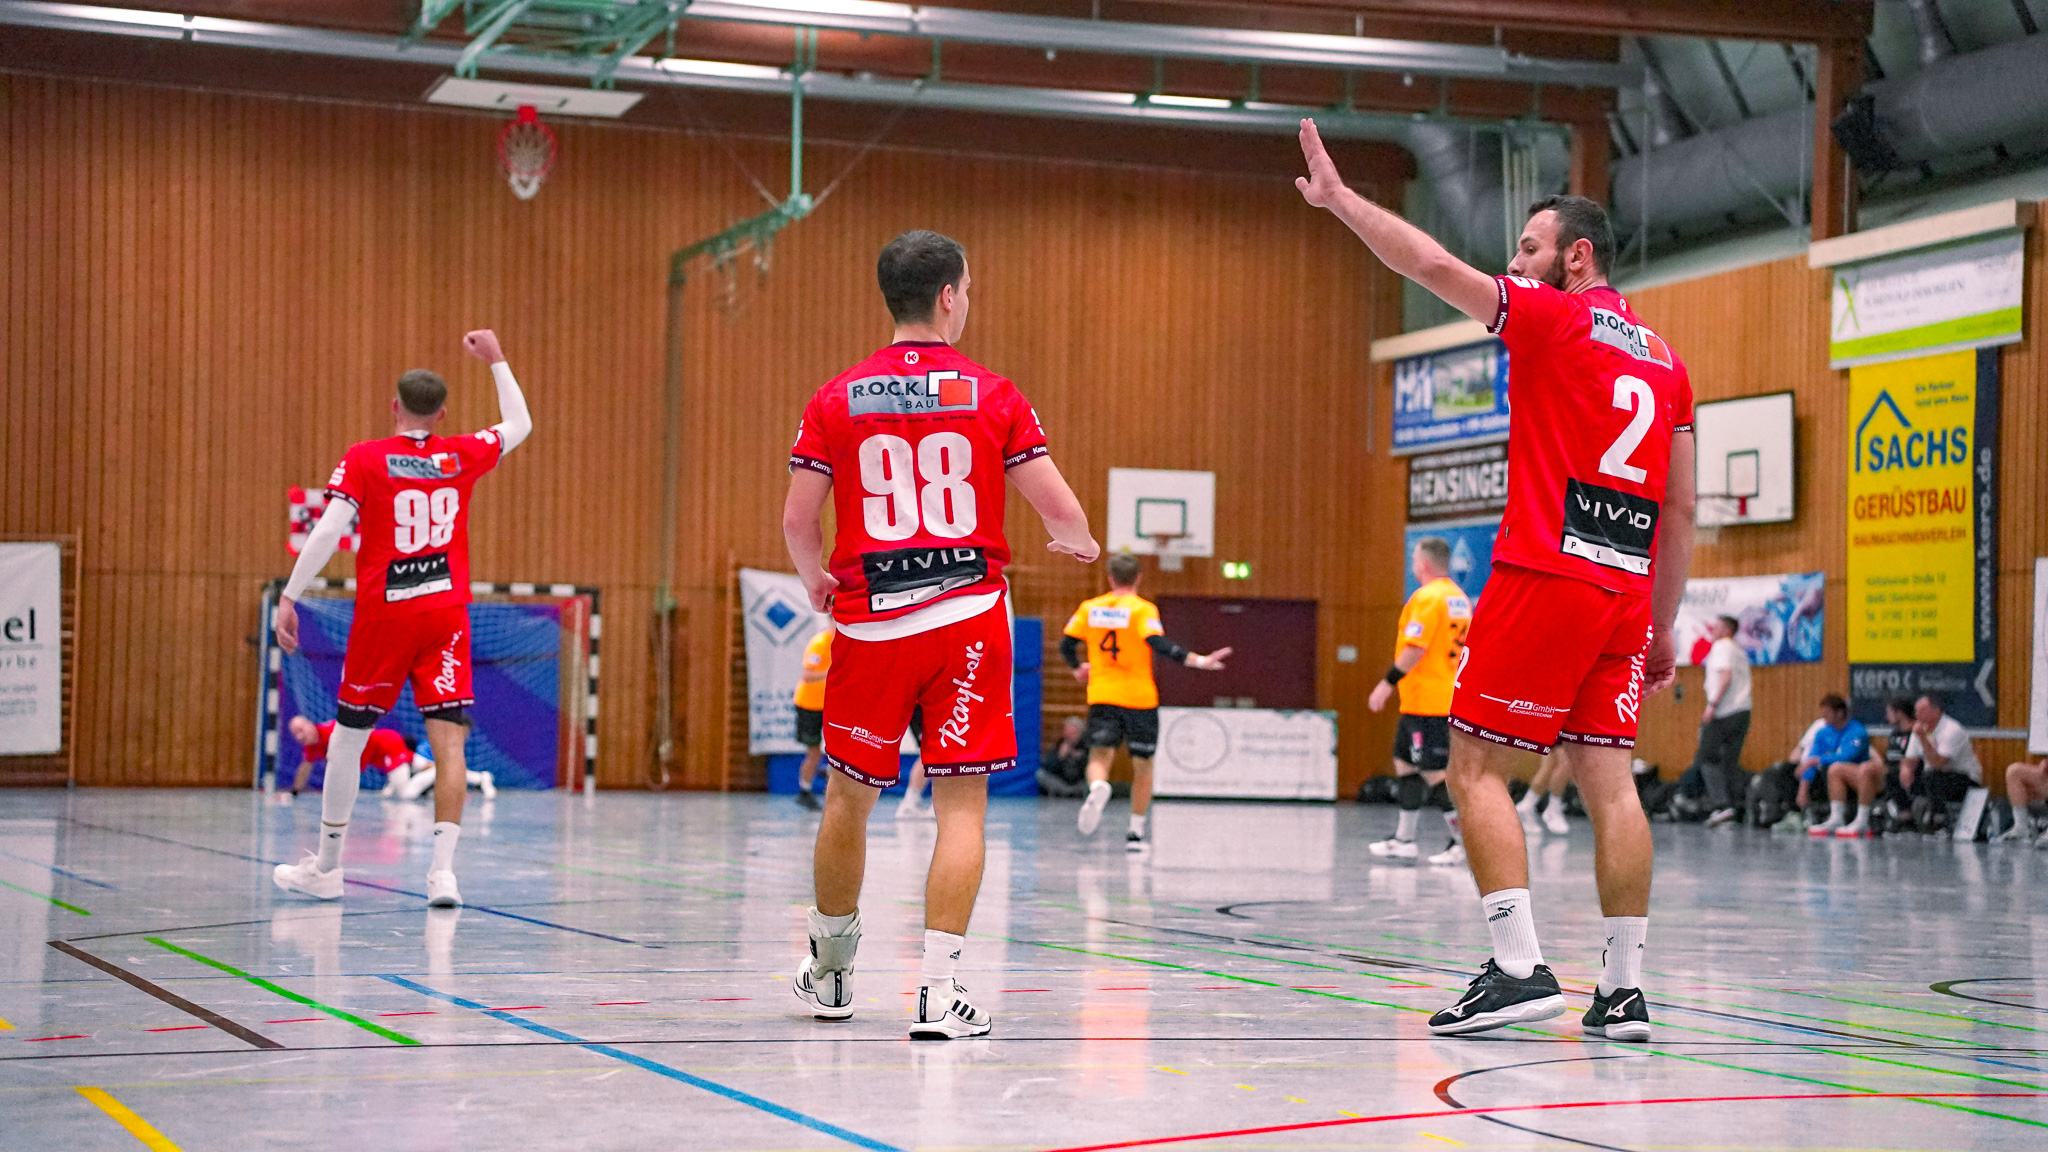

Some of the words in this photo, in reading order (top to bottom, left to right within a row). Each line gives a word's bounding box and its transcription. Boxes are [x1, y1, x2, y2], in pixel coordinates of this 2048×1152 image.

[1497, 279, 1507, 304] Kempa
[852, 381, 924, 399] R.O.C.K.
[1598, 375, 1655, 485] 2
[1868, 425, 1968, 473] SACHS
[811, 460, 833, 475] Kemp
[858, 431, 978, 541] 98
[1575, 493, 1651, 530] VIVID
[1854, 485, 1967, 521] GERÜSTBAU
[394, 487, 459, 554] 99
[393, 556, 446, 575] VIVI
[876, 547, 977, 572] VIVID
[1099, 630, 1121, 661] 4
[1453, 718, 1474, 733] Kempa
[1479, 729, 1507, 743] Kempa
[1513, 738, 1538, 751] Kempa
[1583, 734, 1613, 745] Kempa
[1619, 737, 1635, 748] Kemp
[844, 764, 864, 781] Kempa
[869, 777, 896, 788] Kempa
[927, 766, 952, 775] Kempa
[959, 765, 986, 775] Kempa
[991, 761, 1008, 771] Kempa
